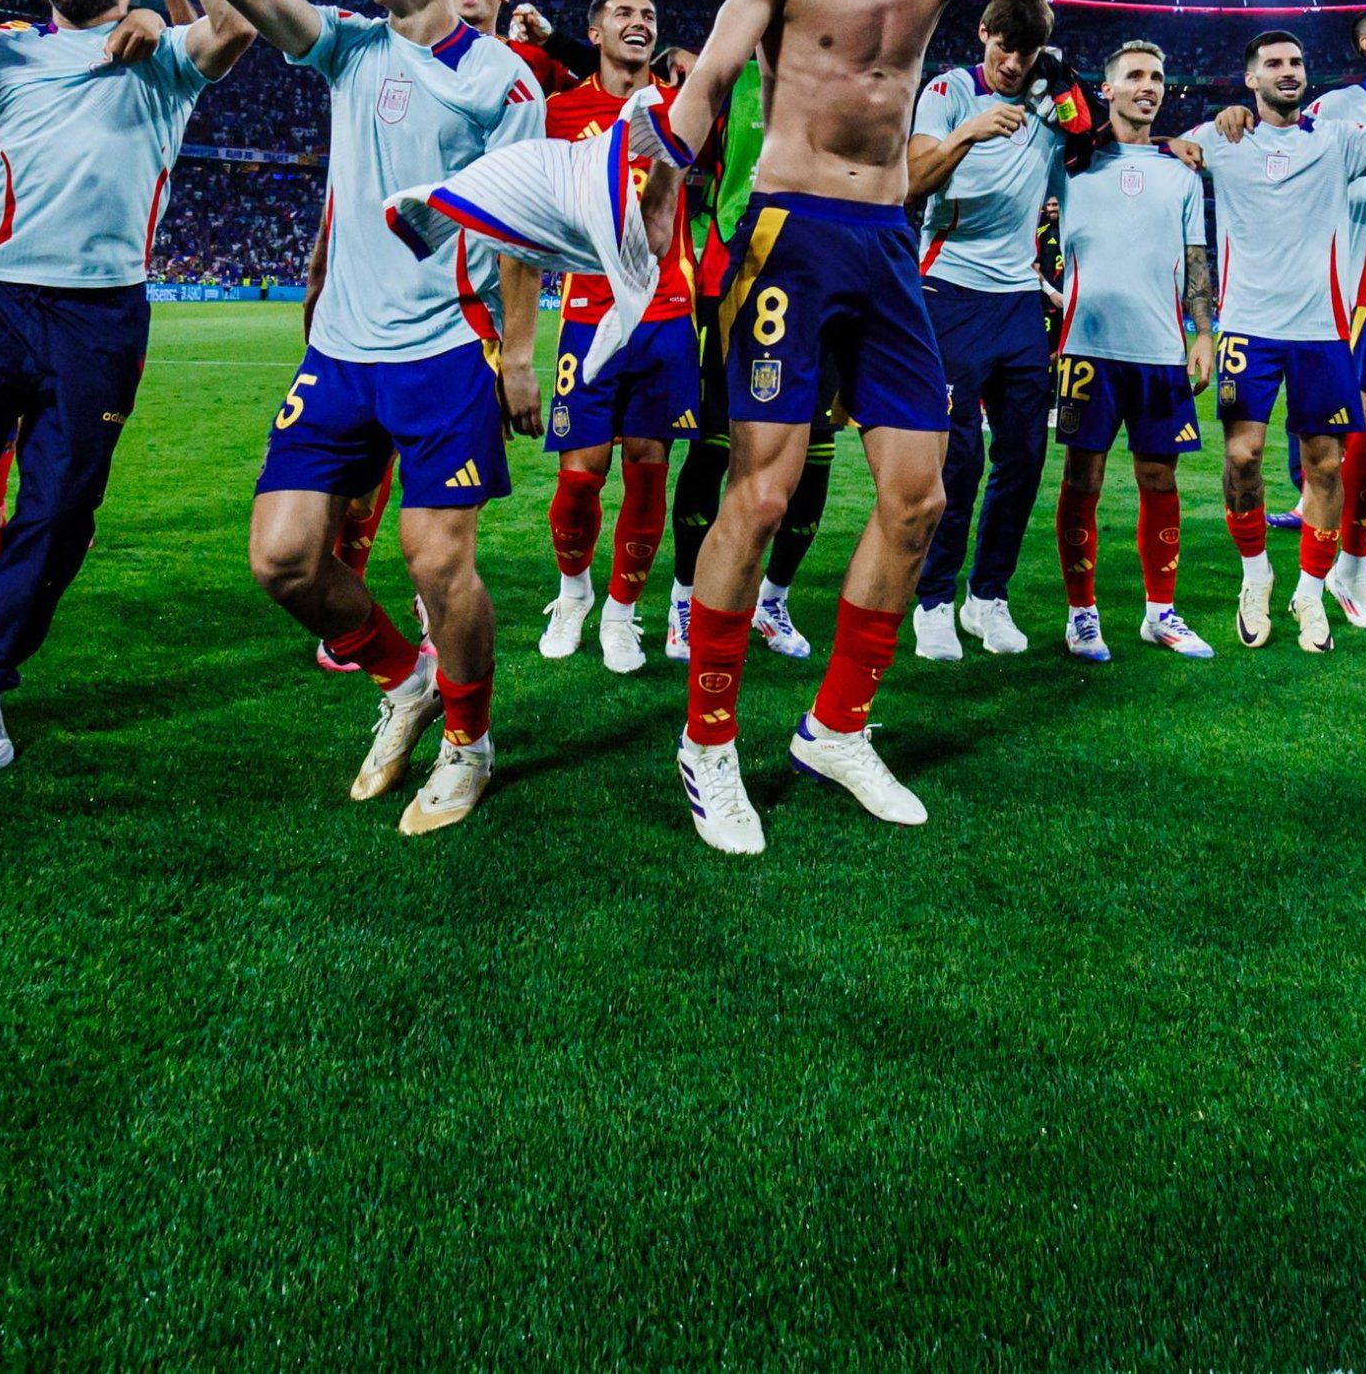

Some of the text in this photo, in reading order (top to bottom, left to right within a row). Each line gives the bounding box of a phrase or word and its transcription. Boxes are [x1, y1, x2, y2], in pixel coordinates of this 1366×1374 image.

[753, 287, 789, 345] 8
[556, 352, 578, 396] 8
[1218, 337, 1249, 374] 15
[1058, 357, 1095, 401] 12
[275, 373, 318, 430] 5
